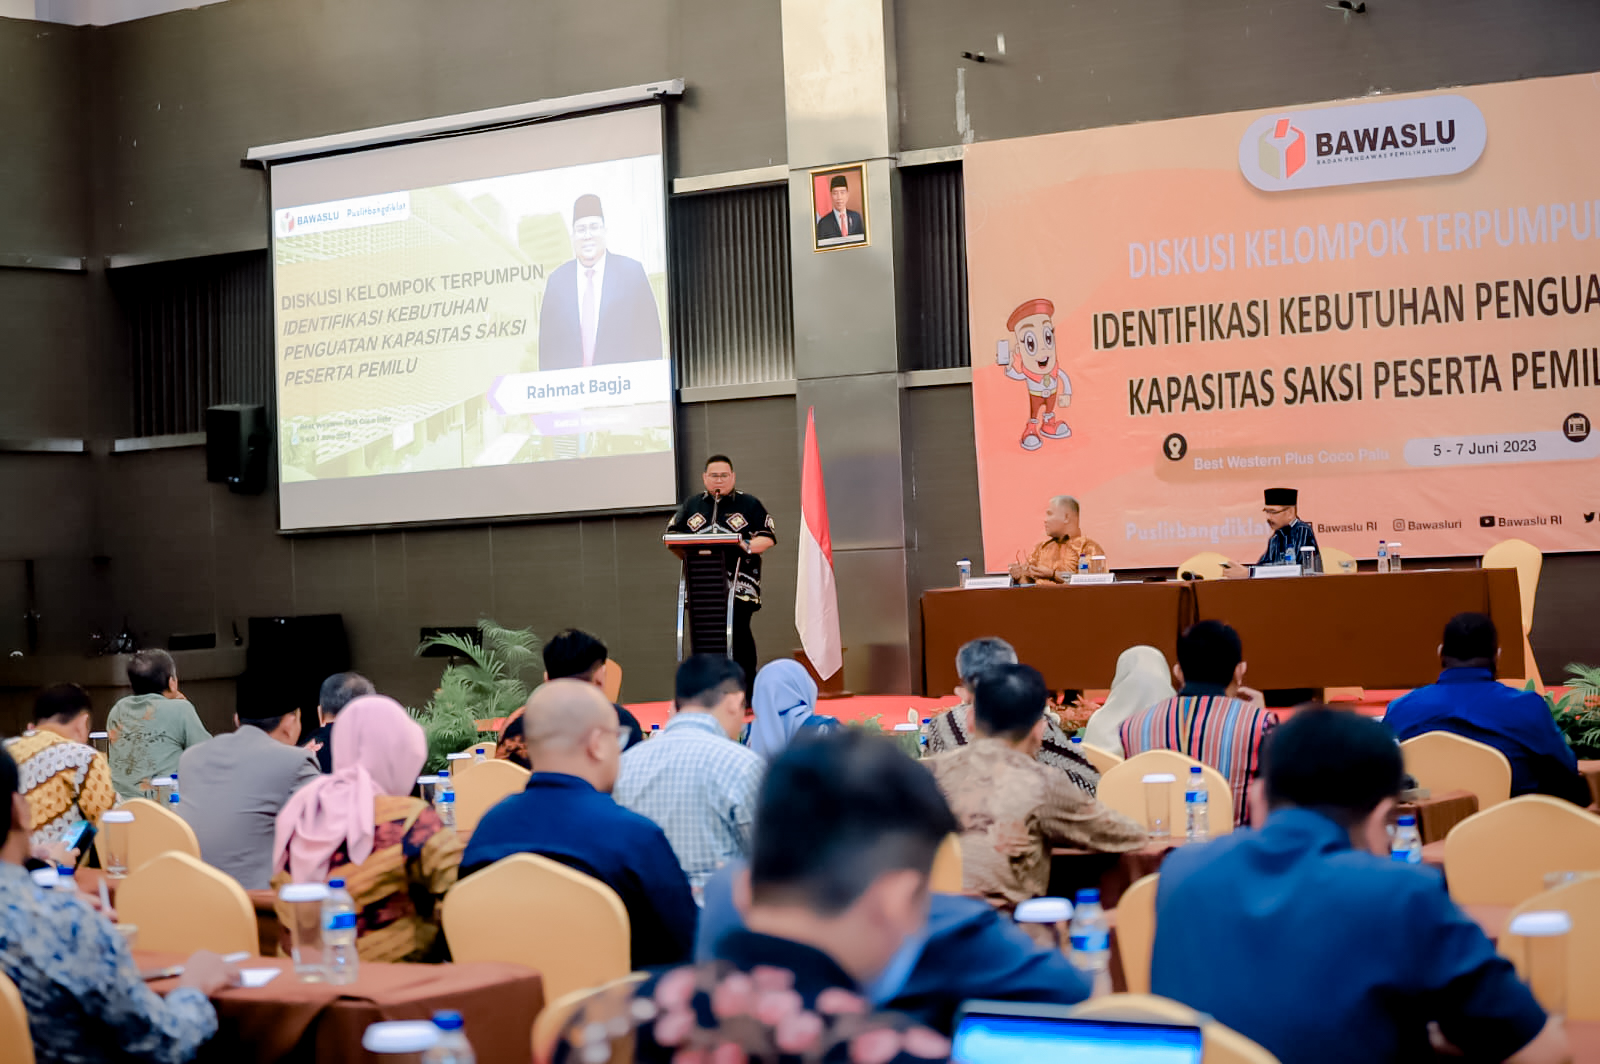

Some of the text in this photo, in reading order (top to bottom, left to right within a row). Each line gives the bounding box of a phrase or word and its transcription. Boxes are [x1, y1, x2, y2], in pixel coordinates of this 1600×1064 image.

[1316, 120, 1456, 157] BAWASLU
[297, 211, 339, 226] BAWASLU
[1128, 200, 1600, 279] DISKUSI KELOMPOK TERPUMPU
[281, 264, 544, 311] DISKUSI KELOMPOK TERPUMPUN
[282, 297, 489, 336] IDENTIFIKASI KEBUTUHAN
[1093, 299, 1269, 350] IDENTIFIKASI
[1280, 283, 1464, 335] KEBUTUHAN
[283, 319, 527, 361] PENGUATAN KAPASITAS SAKSI
[284, 357, 418, 387] PESERTA PEMILU
[527, 375, 631, 399] Rahmat Bagja
[1129, 368, 1275, 416] KAPASITAS
[1283, 362, 1362, 405] SAKSI
[1373, 354, 1503, 400] PESERTA
[1193, 448, 1390, 471] Best Western Plus Coco Palu
[1433, 444, 1442, 457] 5
[1456, 443, 1464, 456] 7
[1468, 441, 1499, 455] Juni
[1503, 439, 1537, 453] 2023
[1317, 521, 1378, 533] Bawaslu RI
[1408, 519, 1462, 531] Bawasluri
[1498, 515, 1562, 527] Bawaslu RI
